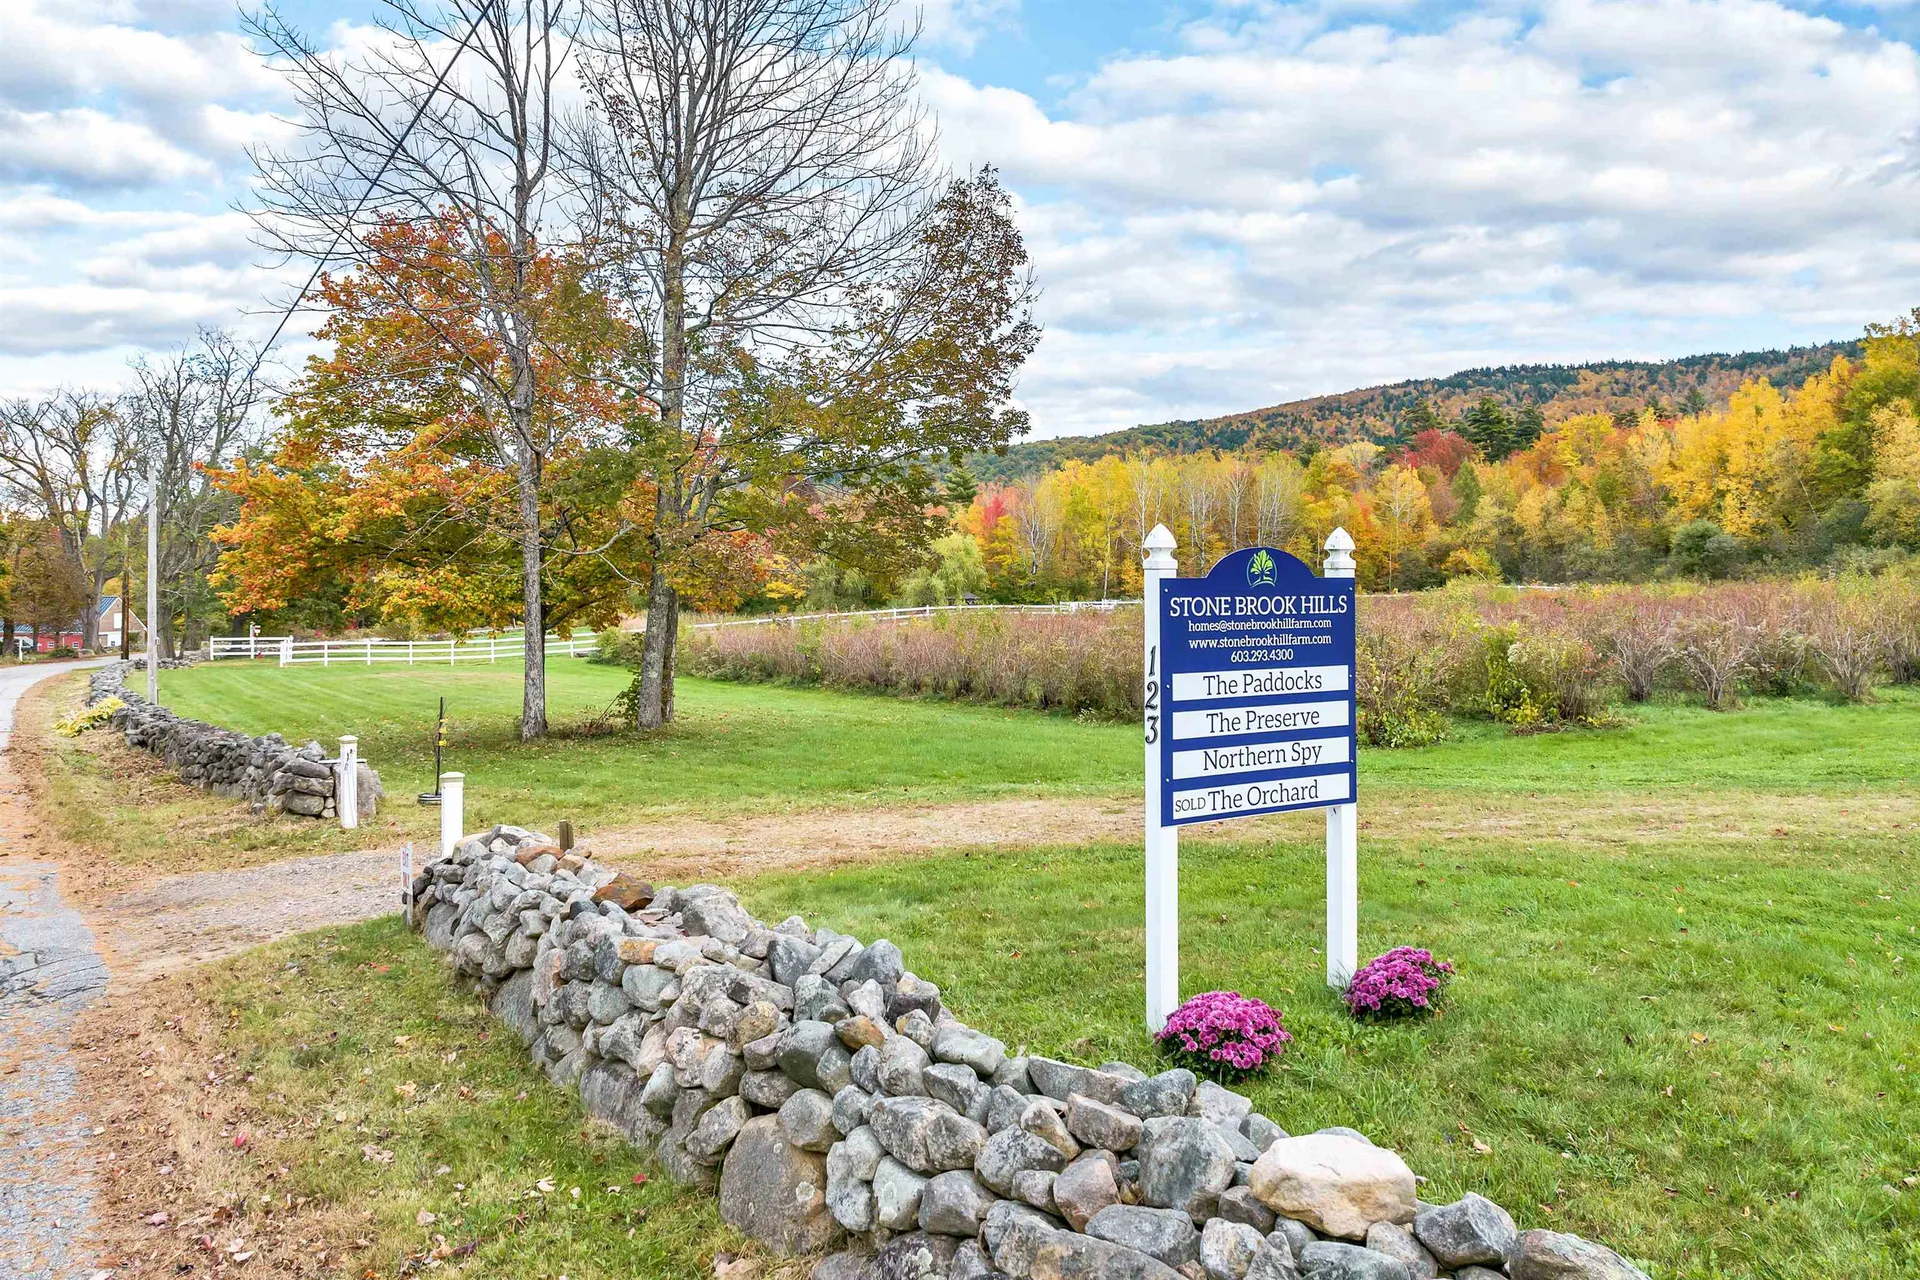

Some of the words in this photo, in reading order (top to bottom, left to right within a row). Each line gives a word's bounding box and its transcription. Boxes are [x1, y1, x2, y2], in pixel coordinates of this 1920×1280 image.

[1170, 597, 1231, 617] STONE
[1235, 596, 1297, 616] BROOK
[1301, 595, 1347, 614] HILLS
[1188, 618, 1332, 632] homes@stonebrookhillfarm.com
[1188, 634, 1332, 649] www.stonebrookhillfarm.com
[1230, 649, 1293, 663] 603.293.4300
[1145, 645, 1159, 744] 123
[1203, 675, 1238, 696] The
[1242, 670, 1322, 693] Paddocks
[1206, 713, 1241, 733] The
[1245, 710, 1320, 730] Preserve
[1203, 747, 1286, 771] Northern
[1291, 742, 1322, 764] Spy
[1175, 797, 1206, 812] SOLD
[1208, 790, 1243, 811] The
[1247, 779, 1319, 806] Orchard
